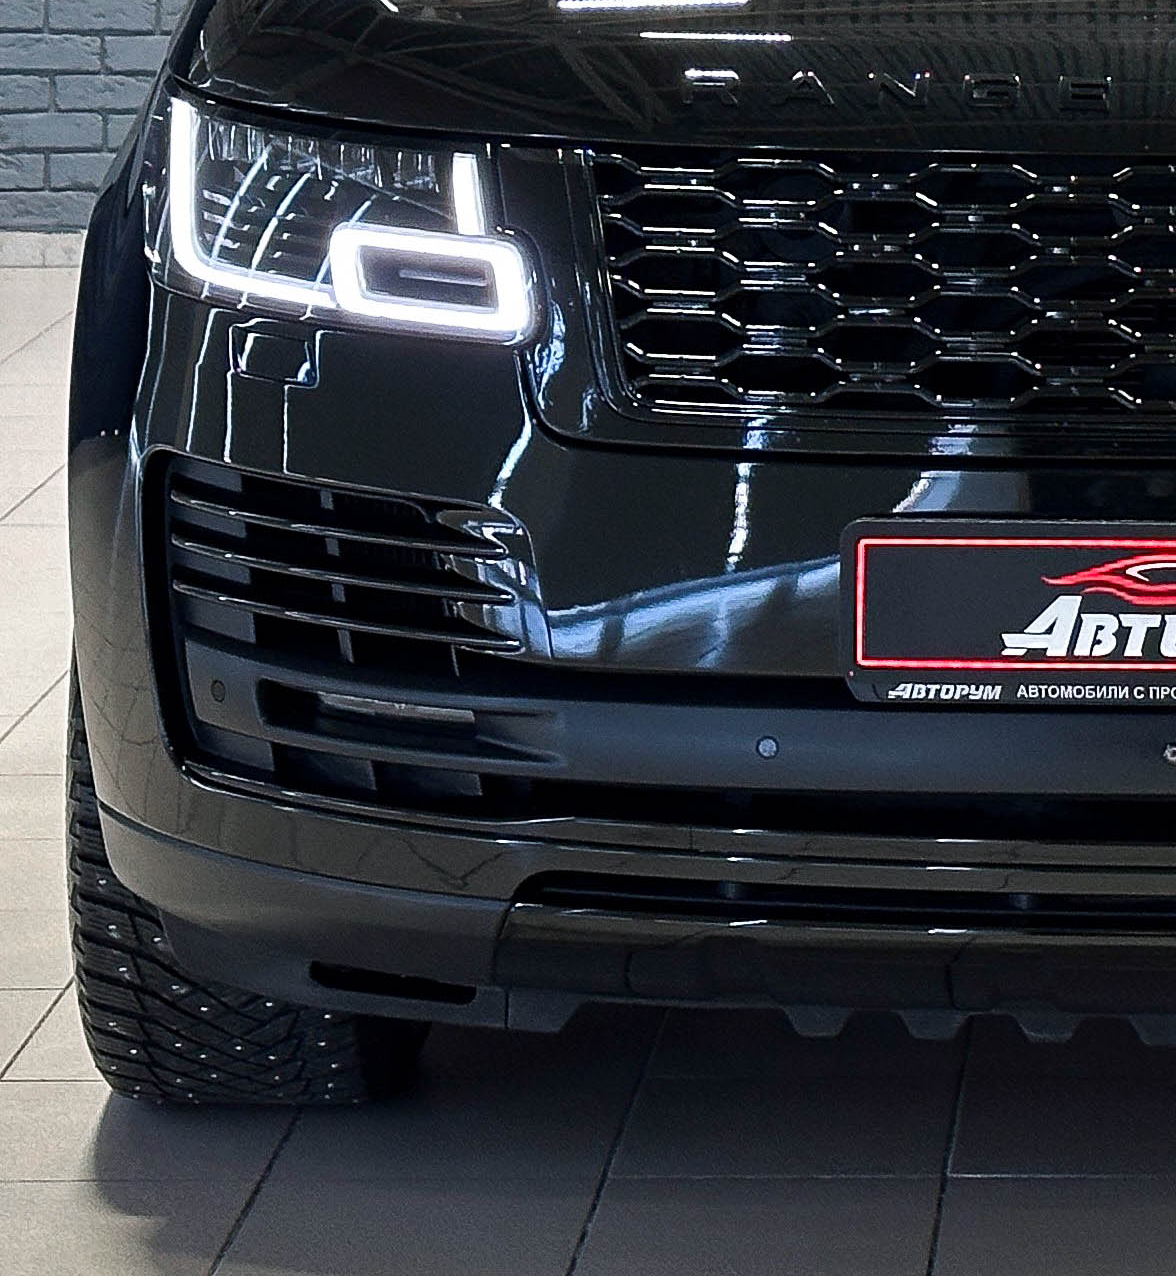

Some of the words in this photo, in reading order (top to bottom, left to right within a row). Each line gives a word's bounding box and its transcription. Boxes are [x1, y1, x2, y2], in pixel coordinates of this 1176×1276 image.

[682, 67, 1112, 112] RANGE
[1016, 683, 1130, 700] АВТОМОБИЛИ
[1133, 685, 1146, 700] С
